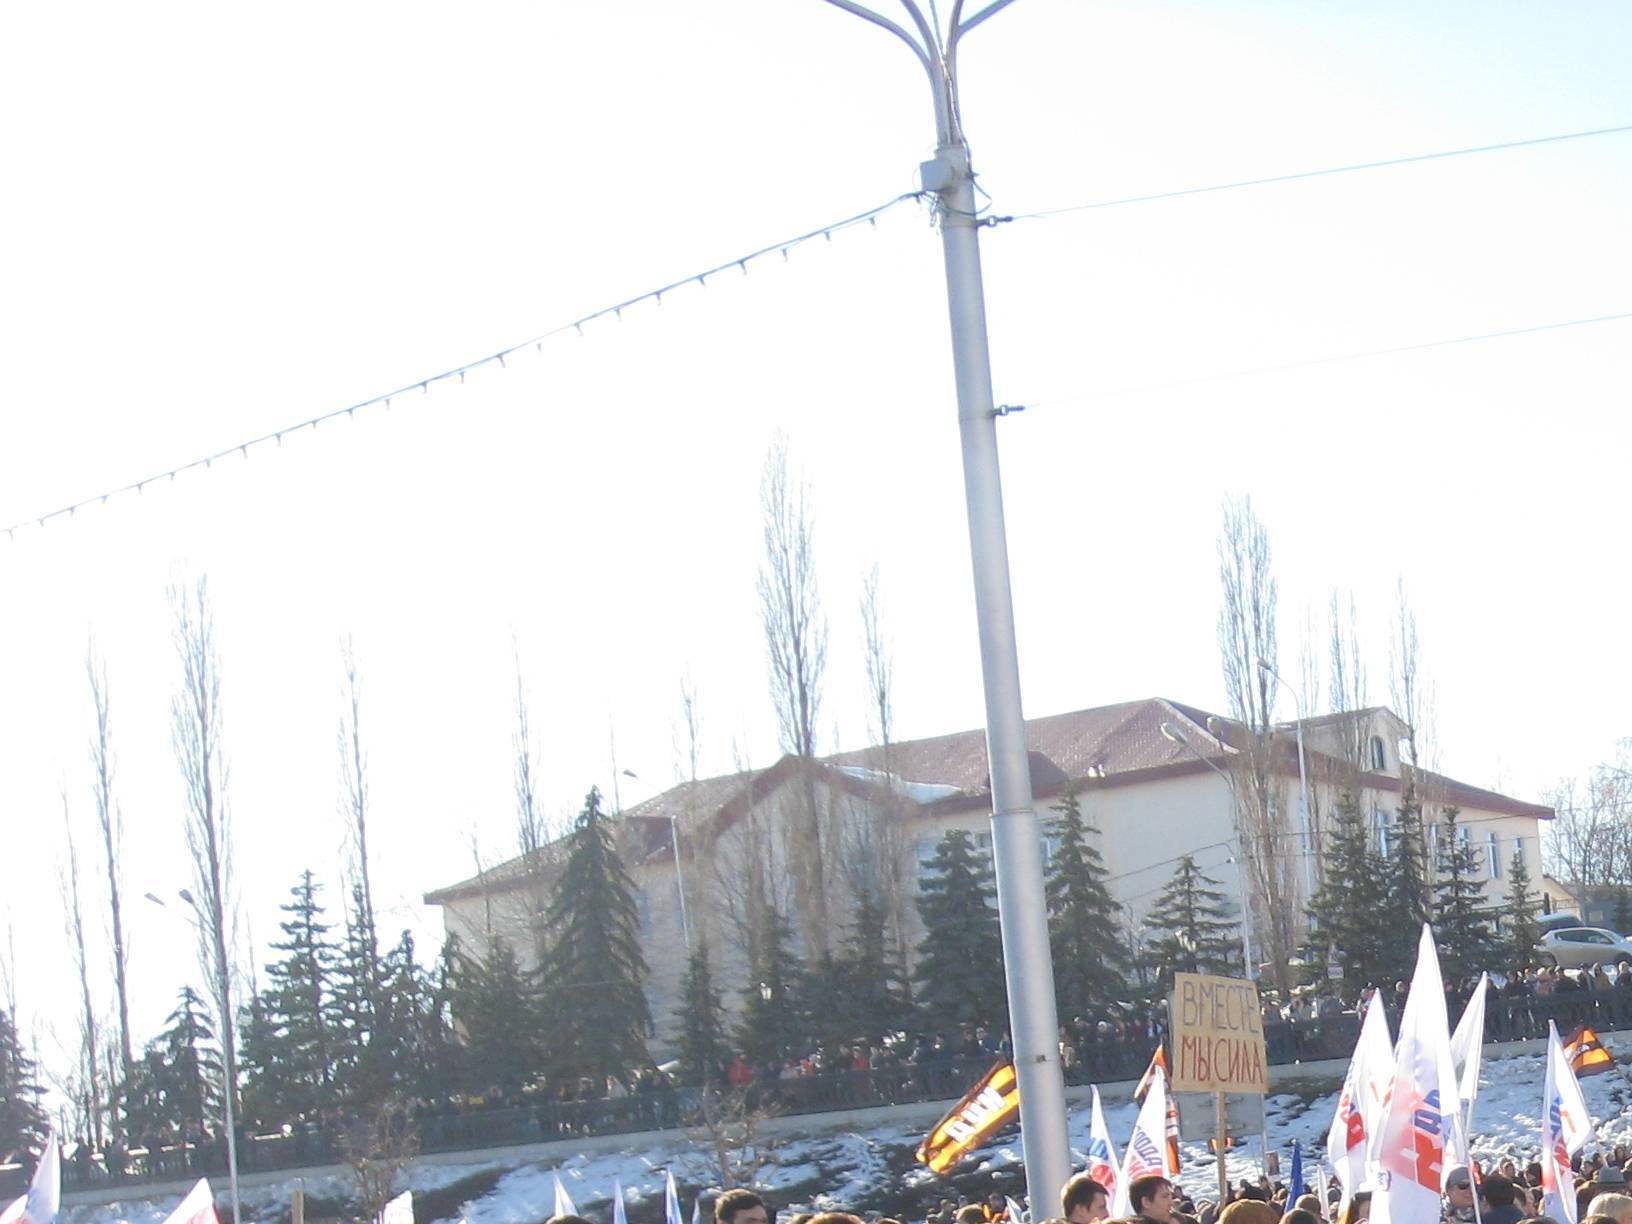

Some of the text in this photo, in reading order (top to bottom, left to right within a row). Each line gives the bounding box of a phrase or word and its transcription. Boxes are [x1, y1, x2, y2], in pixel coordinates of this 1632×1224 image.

[1182, 980, 1259, 1034] ВМЕСТЕ
[1180, 1034, 1264, 1085] МЫ СИЛА
